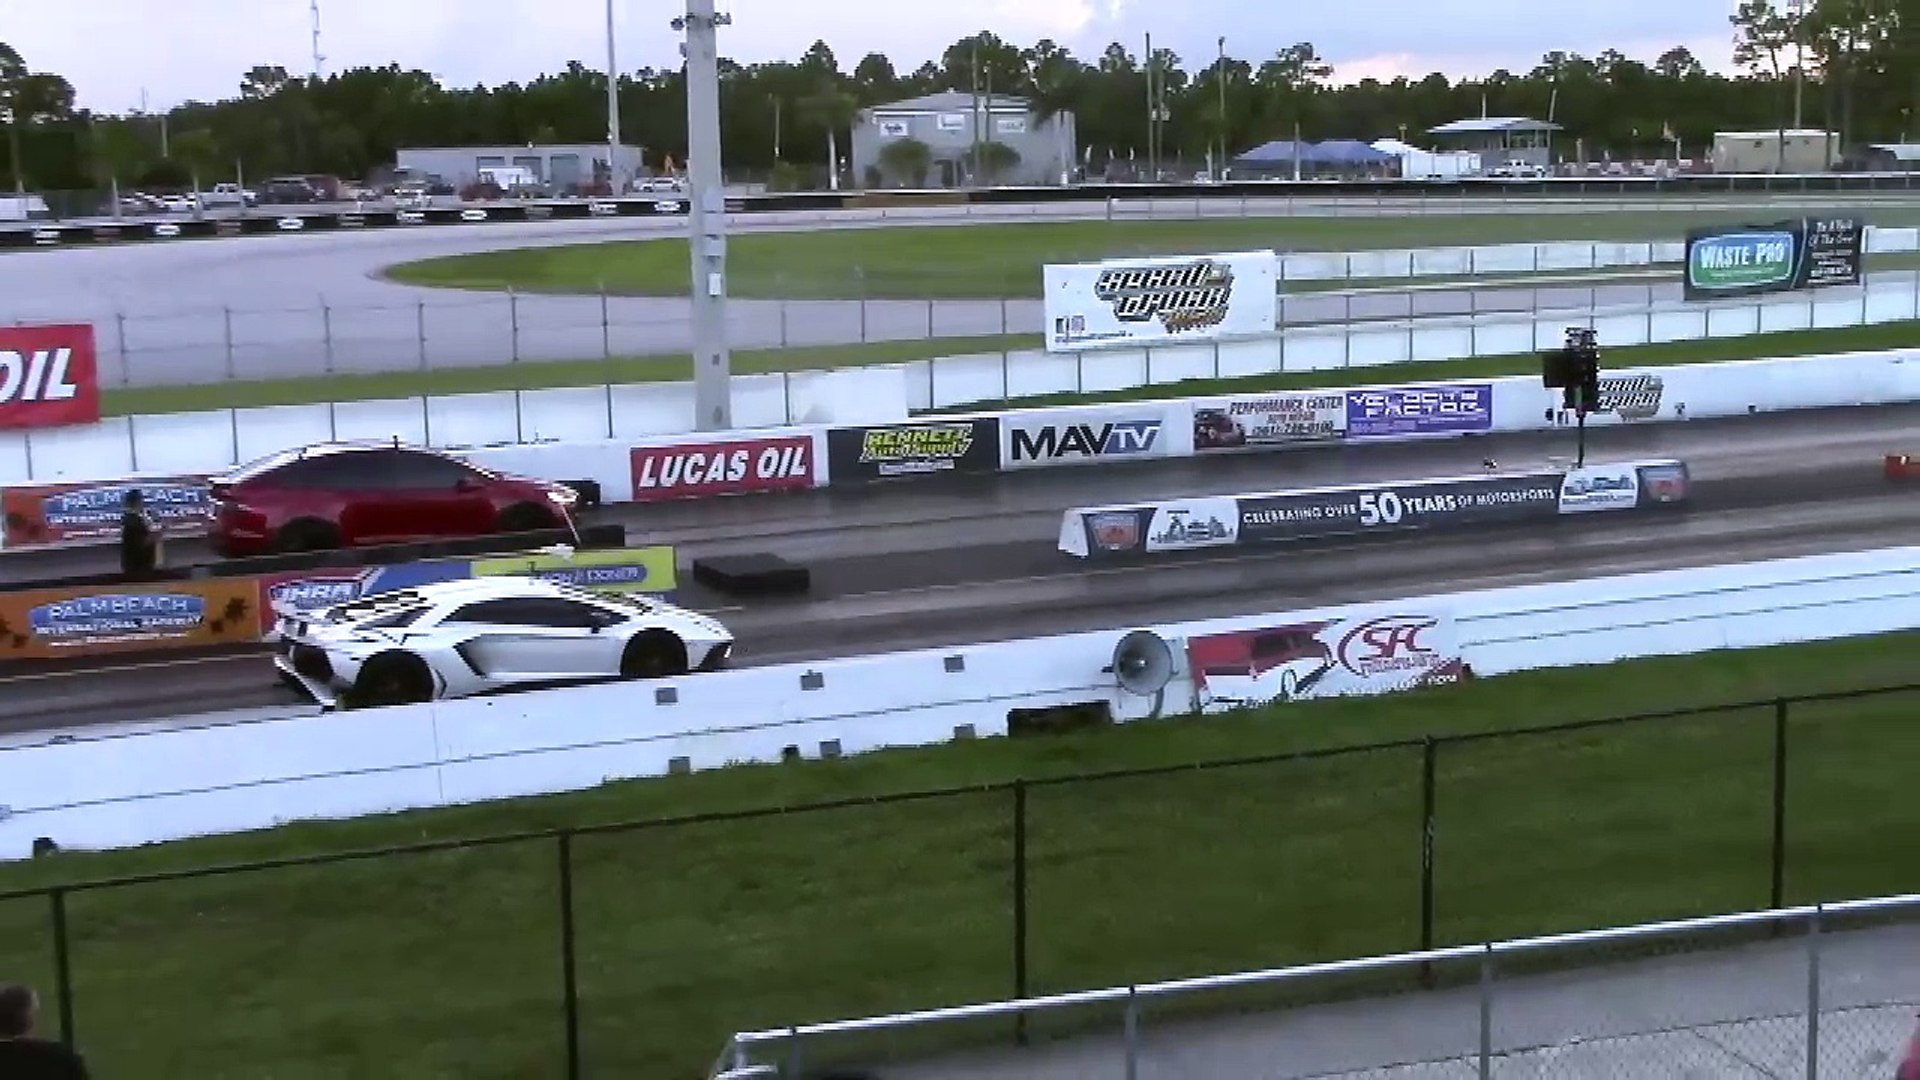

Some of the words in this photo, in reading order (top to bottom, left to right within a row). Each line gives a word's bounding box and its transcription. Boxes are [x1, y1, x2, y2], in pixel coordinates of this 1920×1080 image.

[1701, 244, 1750, 269] WASTE
[1756, 241, 1785, 265] PRO
[0, 348, 77, 404] OIL
[1230, 398, 1301, 415] PERFORMANCE
[1306, 396, 1344, 410] CENTER
[638, 449, 750, 488] LUCAS
[756, 445, 808, 480] OIL
[62, 491, 121, 511] PALM
[142, 488, 200, 503] EACH
[1243, 506, 1322, 524] CELEBRATING
[1325, 504, 1357, 518] OVER
[1359, 491, 1402, 526] 50
[1402, 494, 1457, 514] YEARS
[1457, 495, 1472, 508] OF
[1476, 488, 1555, 506] MOTORSPORTS
[49, 599, 108, 619] PALM
[110, 597, 189, 615] BEACH
